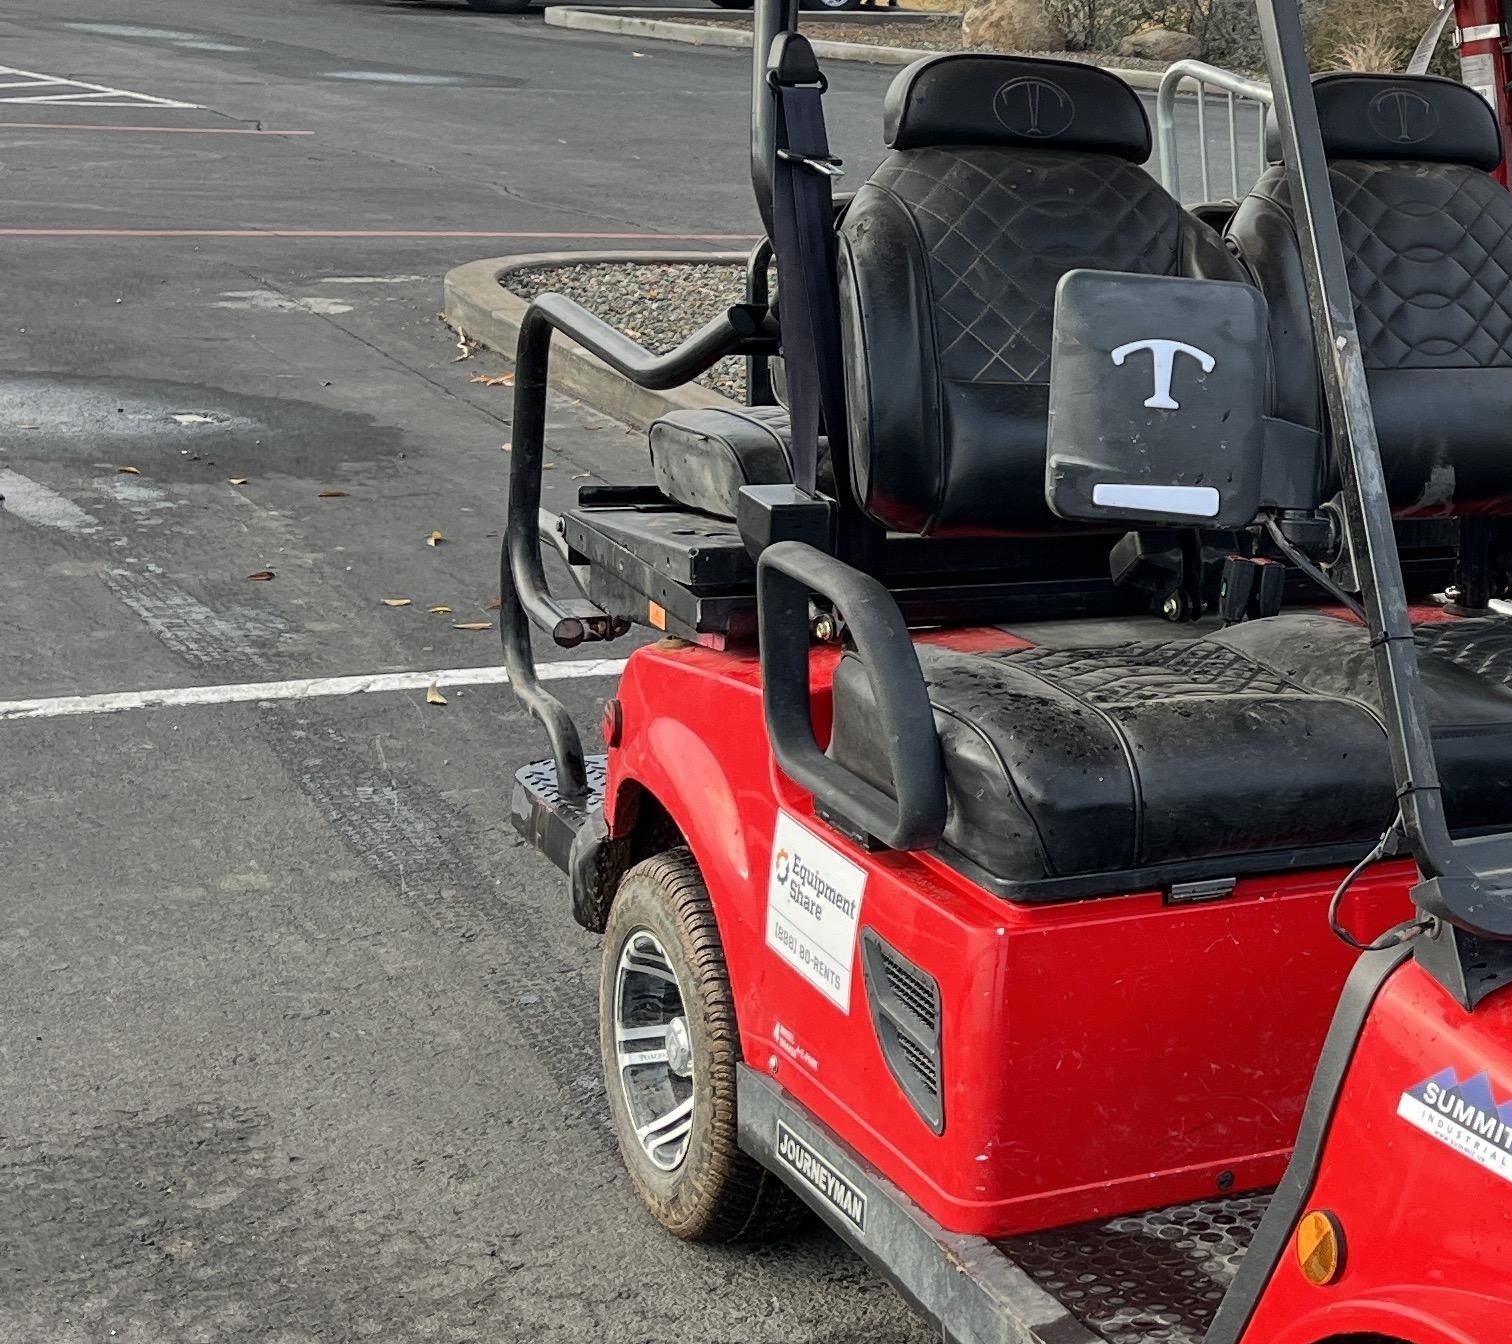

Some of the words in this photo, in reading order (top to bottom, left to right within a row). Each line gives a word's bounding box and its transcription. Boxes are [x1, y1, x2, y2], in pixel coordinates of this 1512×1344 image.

[789, 879, 823, 921] Share
[792, 854, 857, 920] Equipment
[1421, 1110, 1507, 1167] INDUSTRIAL
[780, 1133, 862, 1223] JOURNEYMAN
